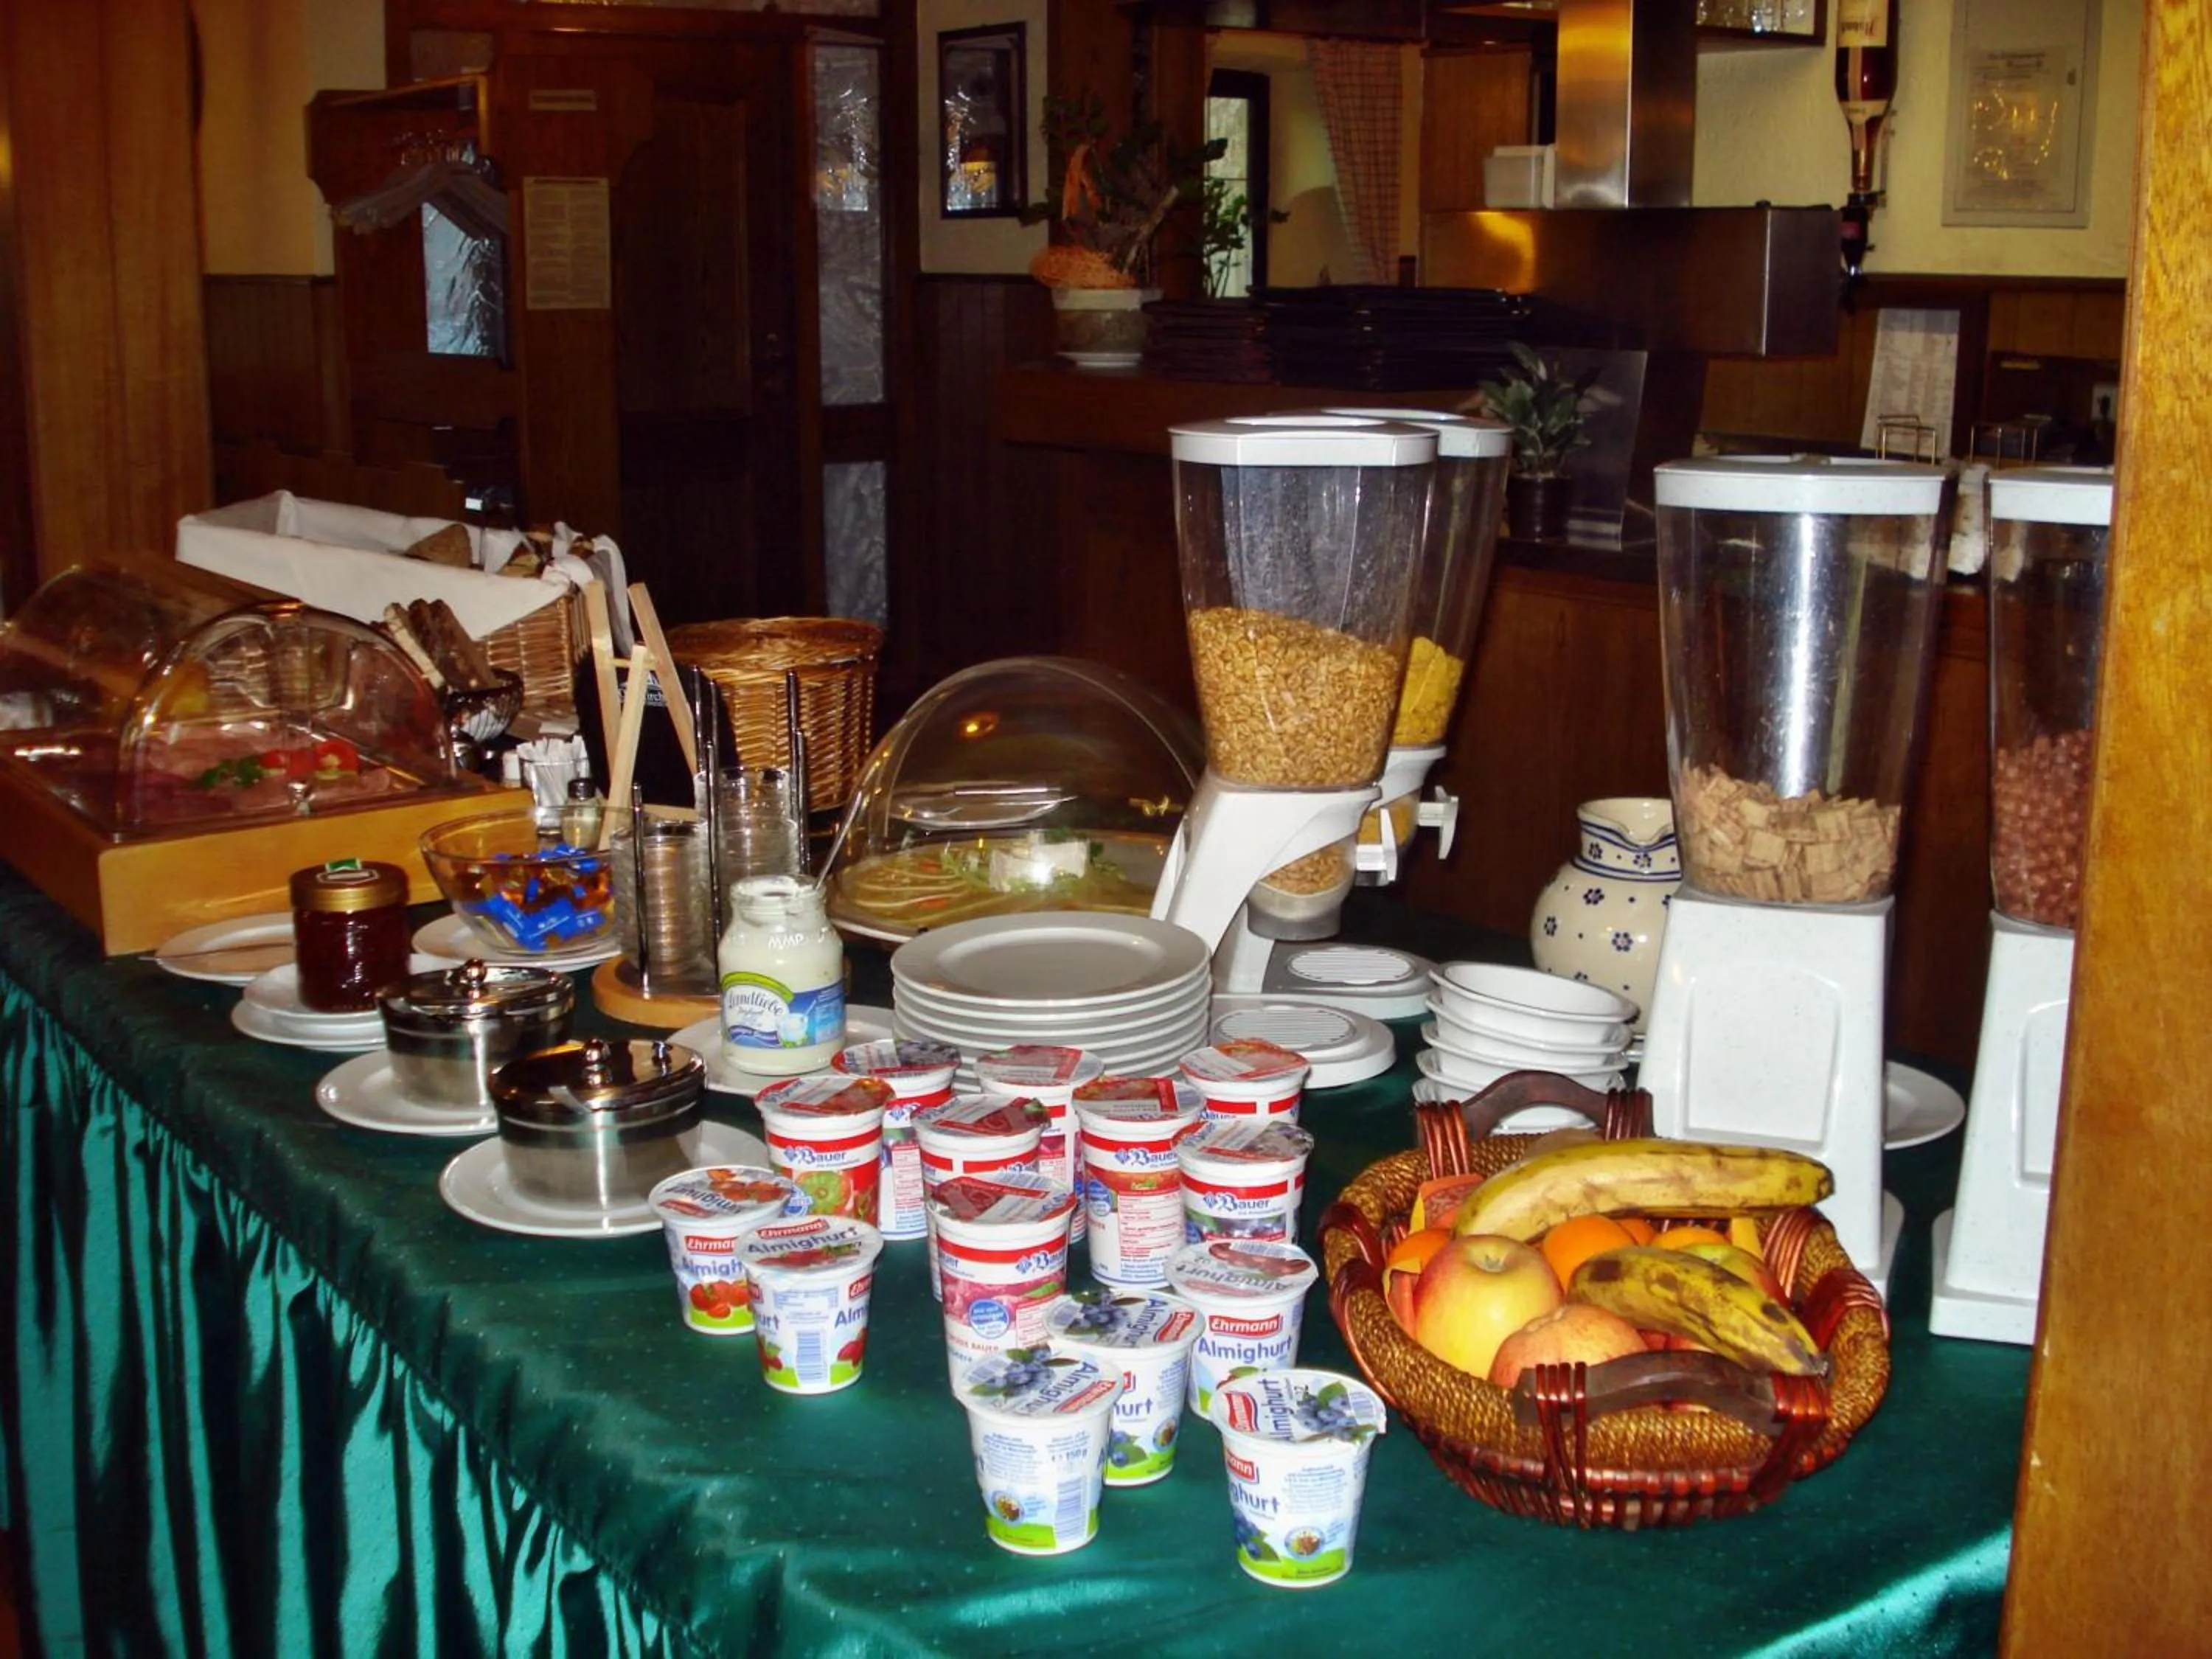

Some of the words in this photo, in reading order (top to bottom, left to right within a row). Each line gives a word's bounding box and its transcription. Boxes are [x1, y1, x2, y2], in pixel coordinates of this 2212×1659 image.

[798, 1147, 846, 1165] Bauer
[1218, 1192, 1270, 1211] Bauer
[760, 1220, 824, 1237] Ehrmann
[748, 1226, 858, 1253] Almighurt
[1211, 1317, 1278, 1333] Ehrmann
[1198, 1336, 1292, 1363] Almighurt
